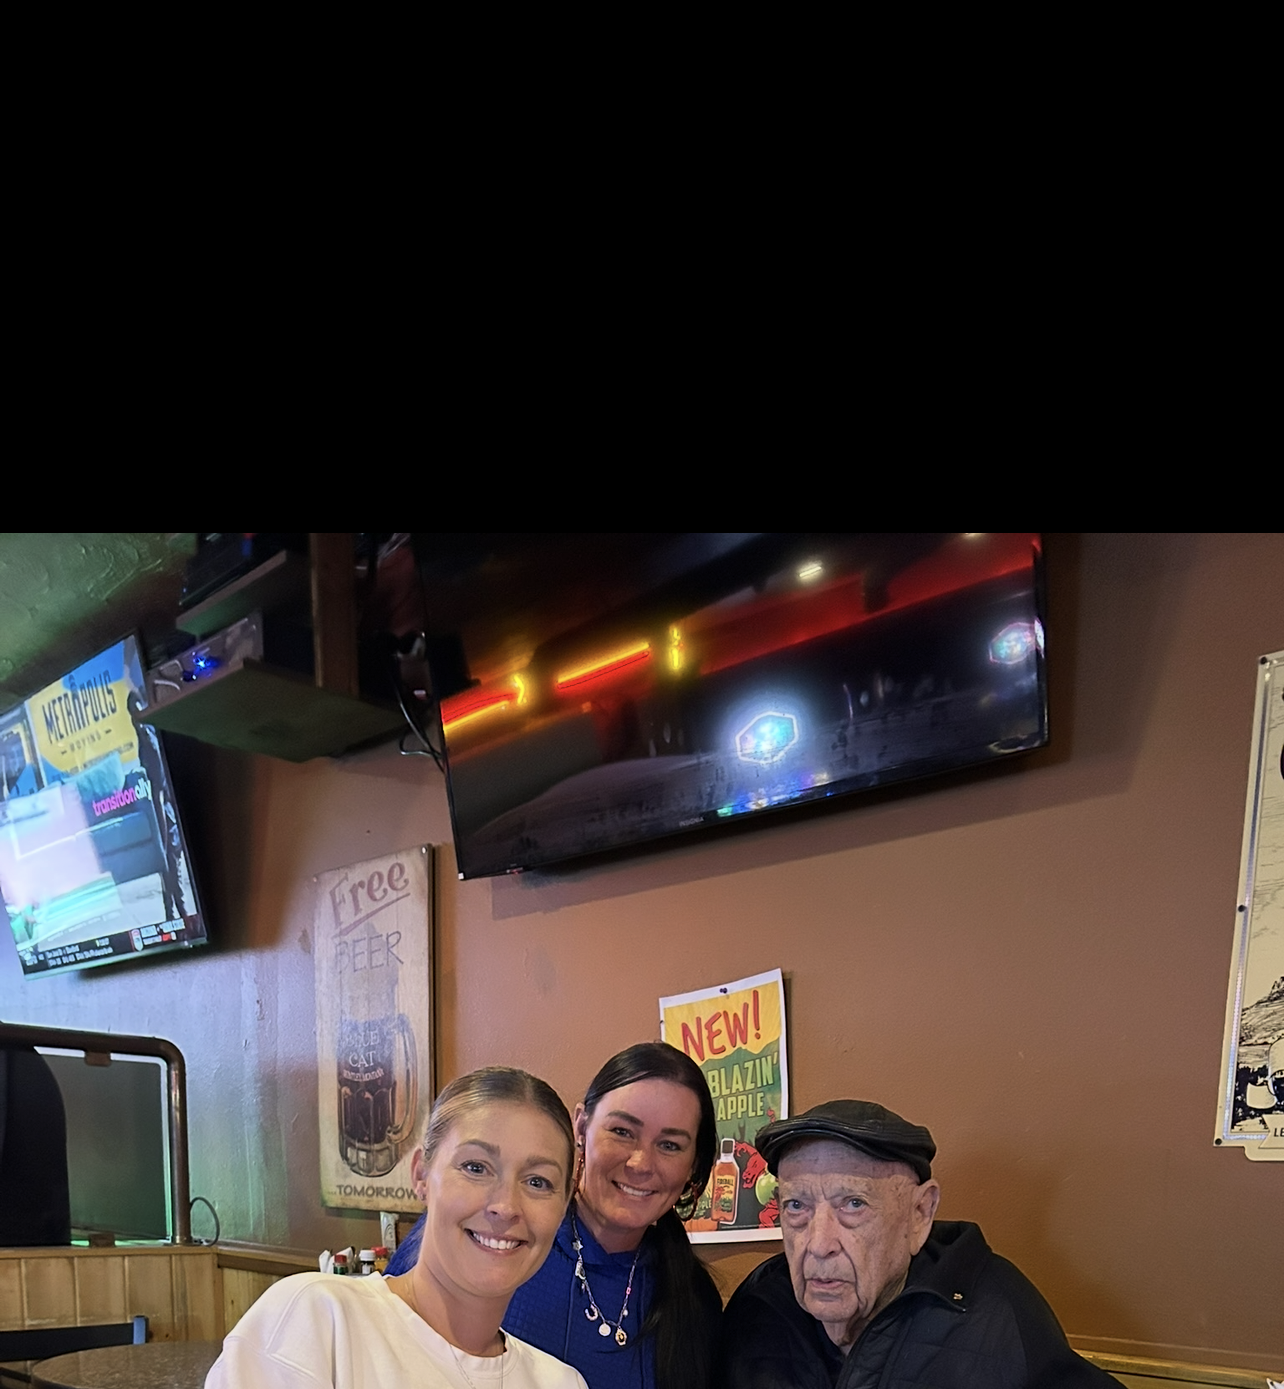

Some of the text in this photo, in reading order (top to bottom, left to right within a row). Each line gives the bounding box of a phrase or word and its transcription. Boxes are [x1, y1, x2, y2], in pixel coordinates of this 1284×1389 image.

[42, 669, 118, 744] METROPOLIS
[329, 862, 410, 929] Free
[334, 930, 404, 974] BEER
[681, 990, 761, 1062] NEW!
[348, 1050, 376, 1068] CAT
[708, 1052, 778, 1099] BLAZIN'
[717, 1092, 765, 1121] APPLE
